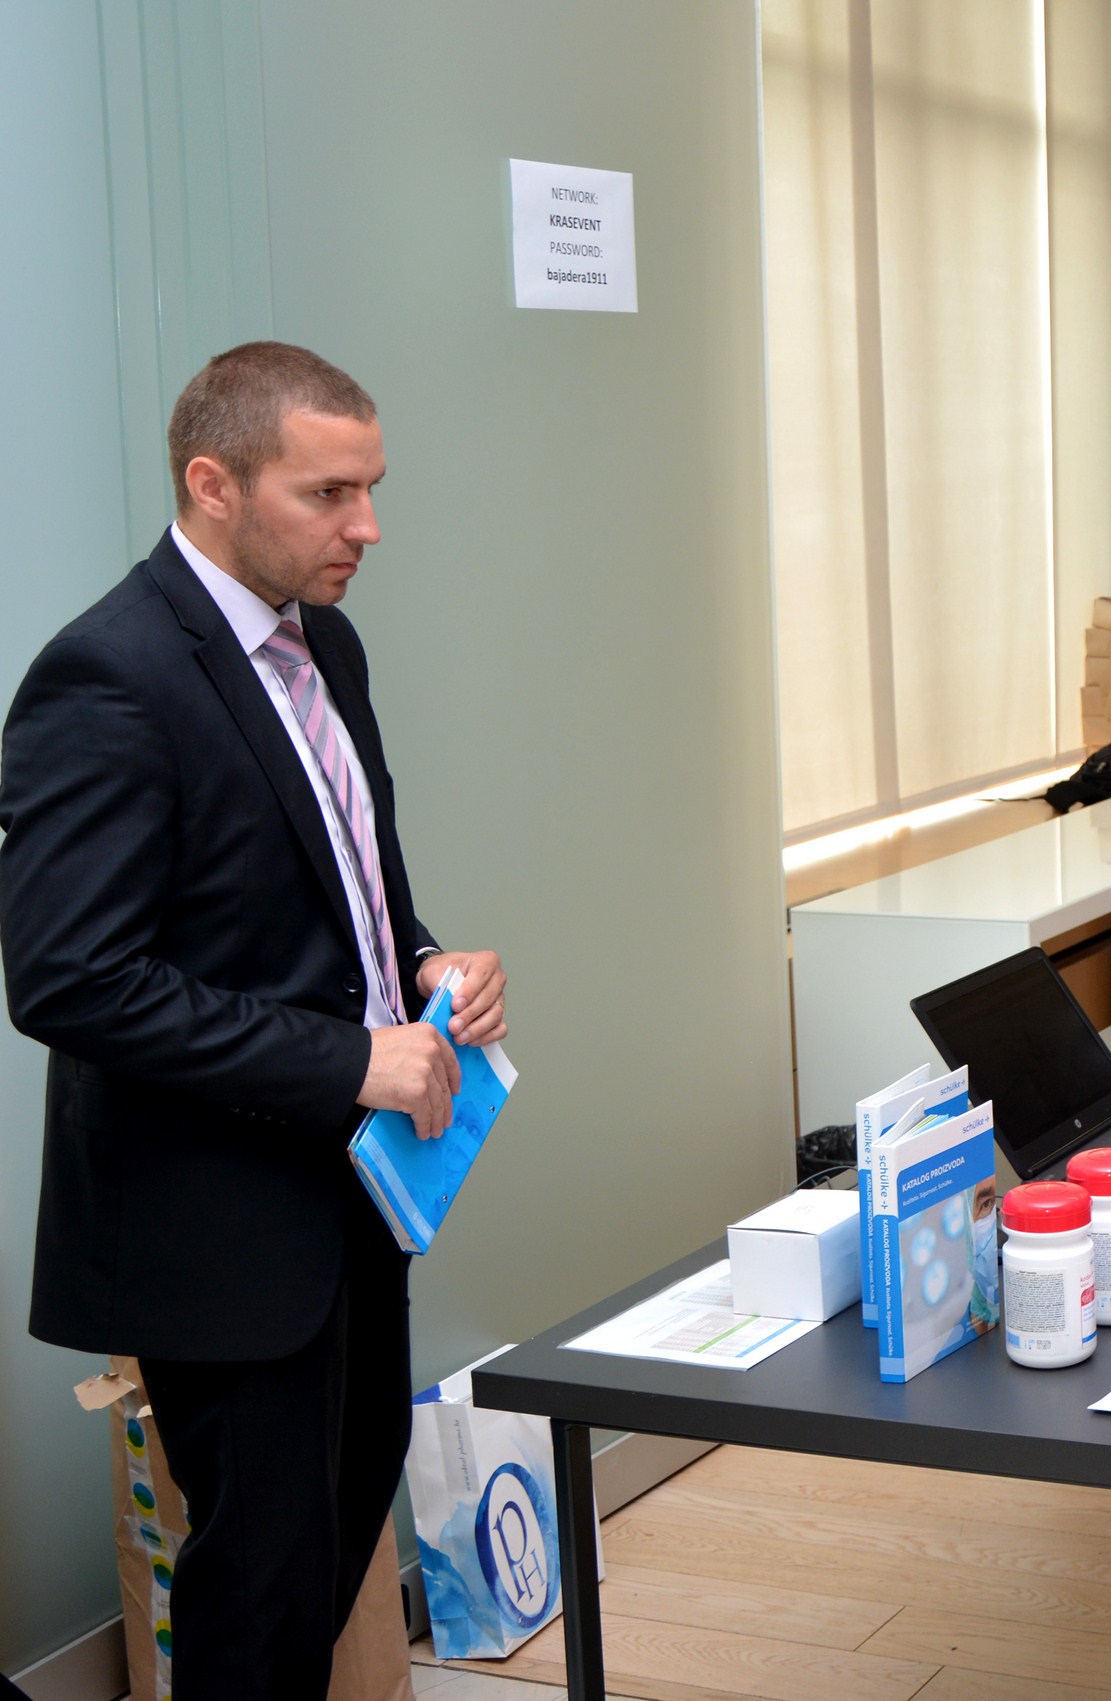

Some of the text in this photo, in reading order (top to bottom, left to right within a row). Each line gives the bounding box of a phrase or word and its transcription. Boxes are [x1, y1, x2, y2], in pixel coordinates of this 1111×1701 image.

[551, 187, 599, 205] NETWORK:
[549, 214, 601, 231] KRASEVENT
[550, 241, 603, 259] PASSWORD:
[547, 267, 608, 285] bajadera1911
[940, 1081, 961, 1096] schülke
[863, 1113, 872, 1153] schülke
[962, 1118, 985, 1134] schülke
[879, 1155, 889, 1197] schülke
[902, 1156, 965, 1193] KATALOG PROIZVODA
[882, 1218, 890, 1248] KATALOG
[884, 1248, 892, 1286] PROIZVODA
